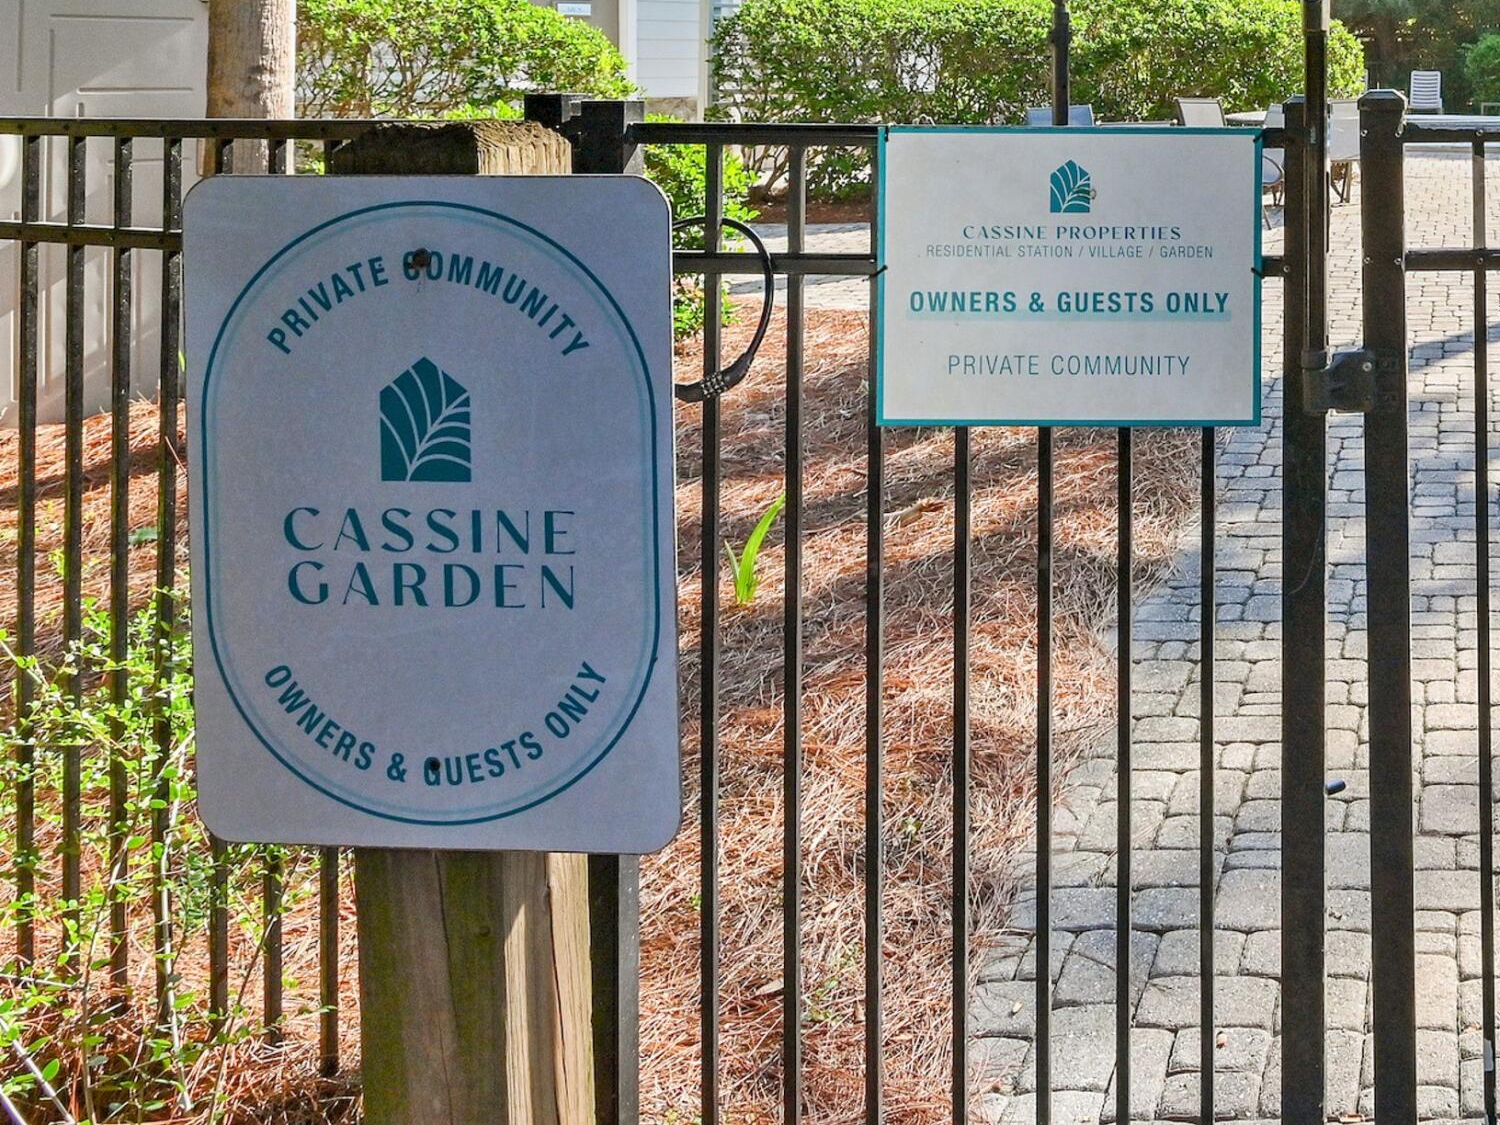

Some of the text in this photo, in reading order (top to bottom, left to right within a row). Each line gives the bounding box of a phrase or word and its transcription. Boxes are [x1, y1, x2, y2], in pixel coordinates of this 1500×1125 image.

[963, 225, 1181, 240] CASSINE PROPERTIES
[926, 245, 1213, 259] RESIDENTIAL STATION / VILLAGE / GARDEN
[267, 250, 590, 357] PRIVATE COMMUNITY
[910, 291, 1230, 313] OWNERS & GUESTS ONLY
[948, 355, 1190, 375] PRIVATE COMMUNITY
[283, 507, 576, 555] CASSINE
[288, 561, 575, 610] GARDEN
[265, 661, 607, 786] OWNERS & GUESTS ONLY
